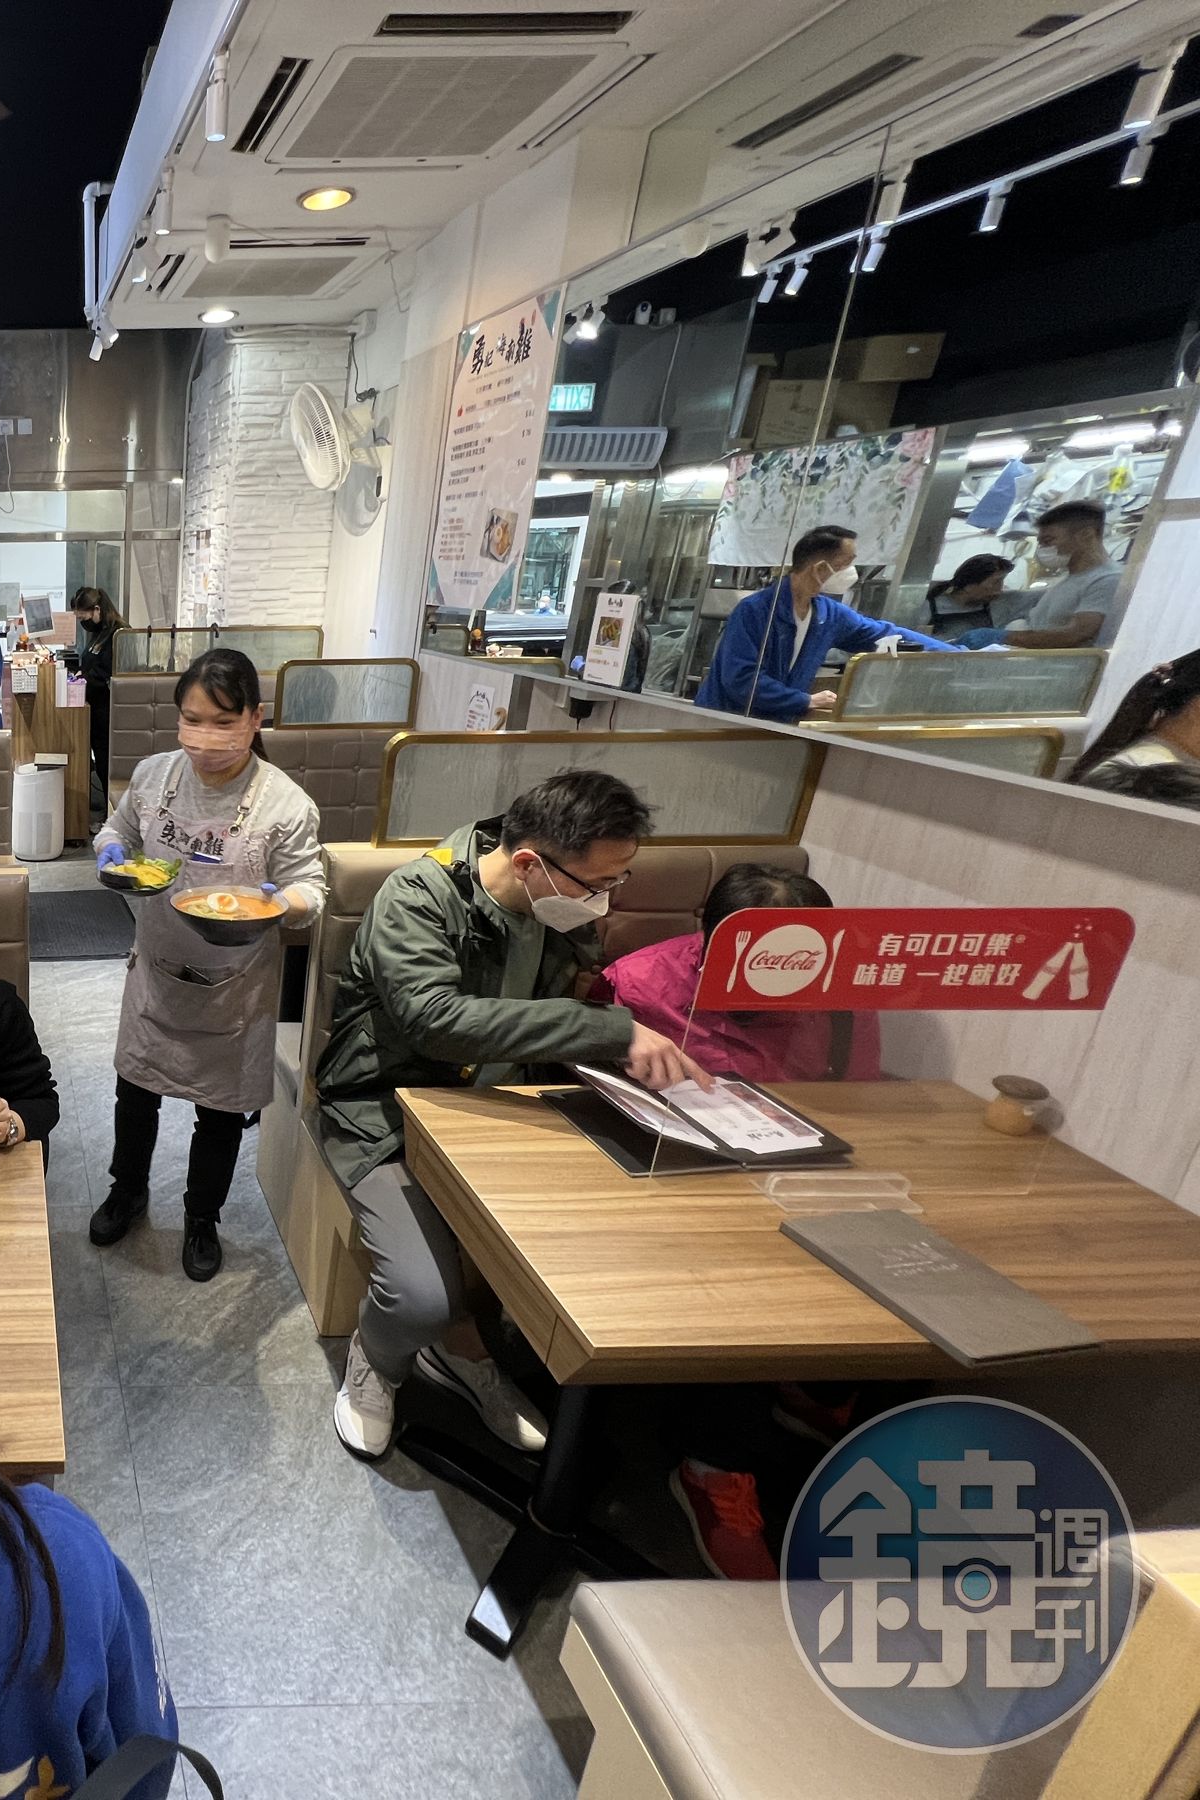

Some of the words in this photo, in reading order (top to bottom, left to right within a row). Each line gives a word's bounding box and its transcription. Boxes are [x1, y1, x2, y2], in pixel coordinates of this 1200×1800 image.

[750, 948, 822, 972] Coca-Cola
[851, 962, 904, 986] 味道
[916, 962, 1021, 986] 一起就好
